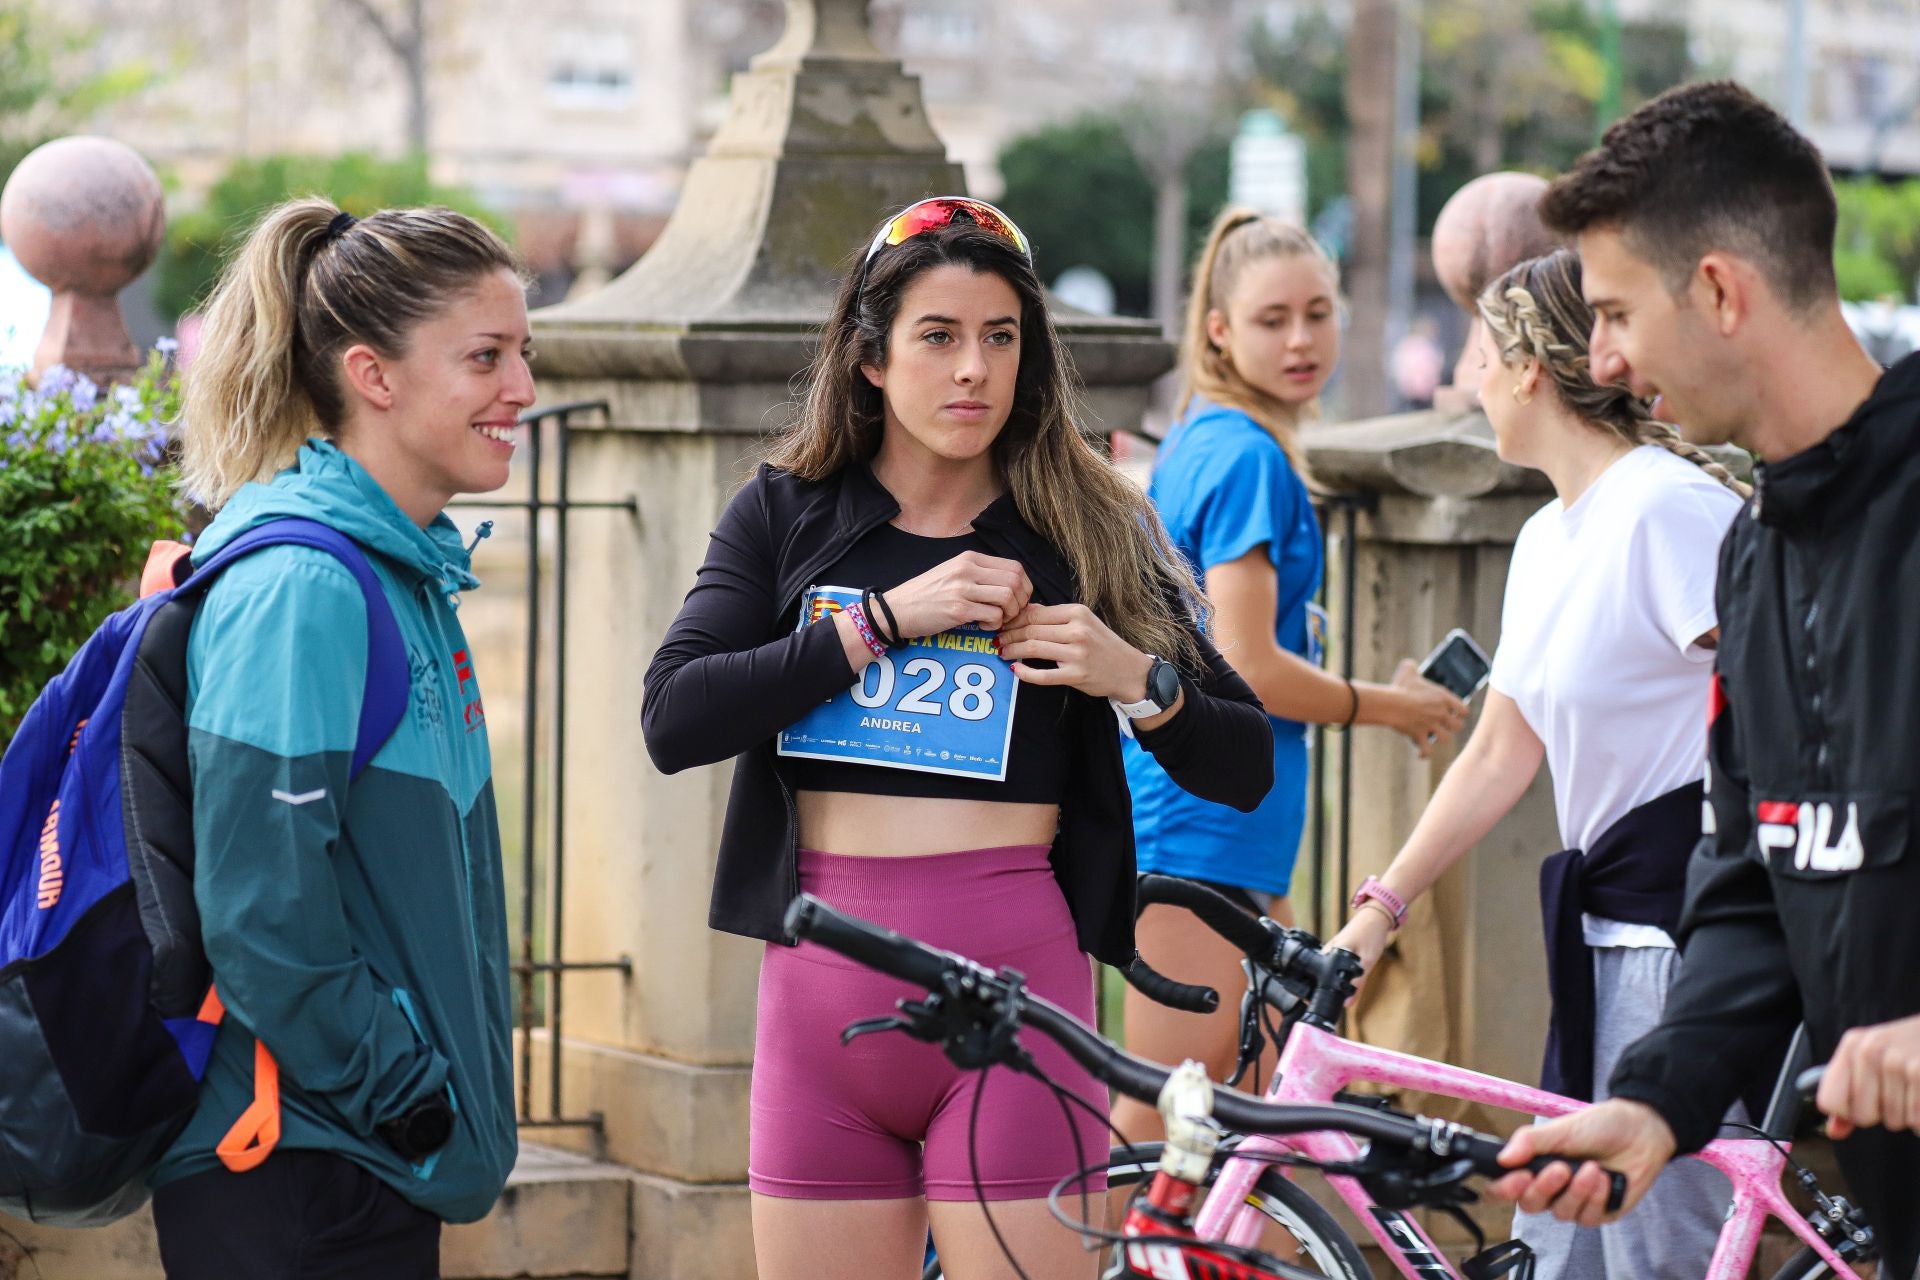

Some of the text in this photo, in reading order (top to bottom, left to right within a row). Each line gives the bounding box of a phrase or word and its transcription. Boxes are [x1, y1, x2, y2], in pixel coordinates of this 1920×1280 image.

[850, 656, 996, 721] 028
[860, 716, 922, 734] ANDREA
[1757, 800, 1865, 871] FILA
